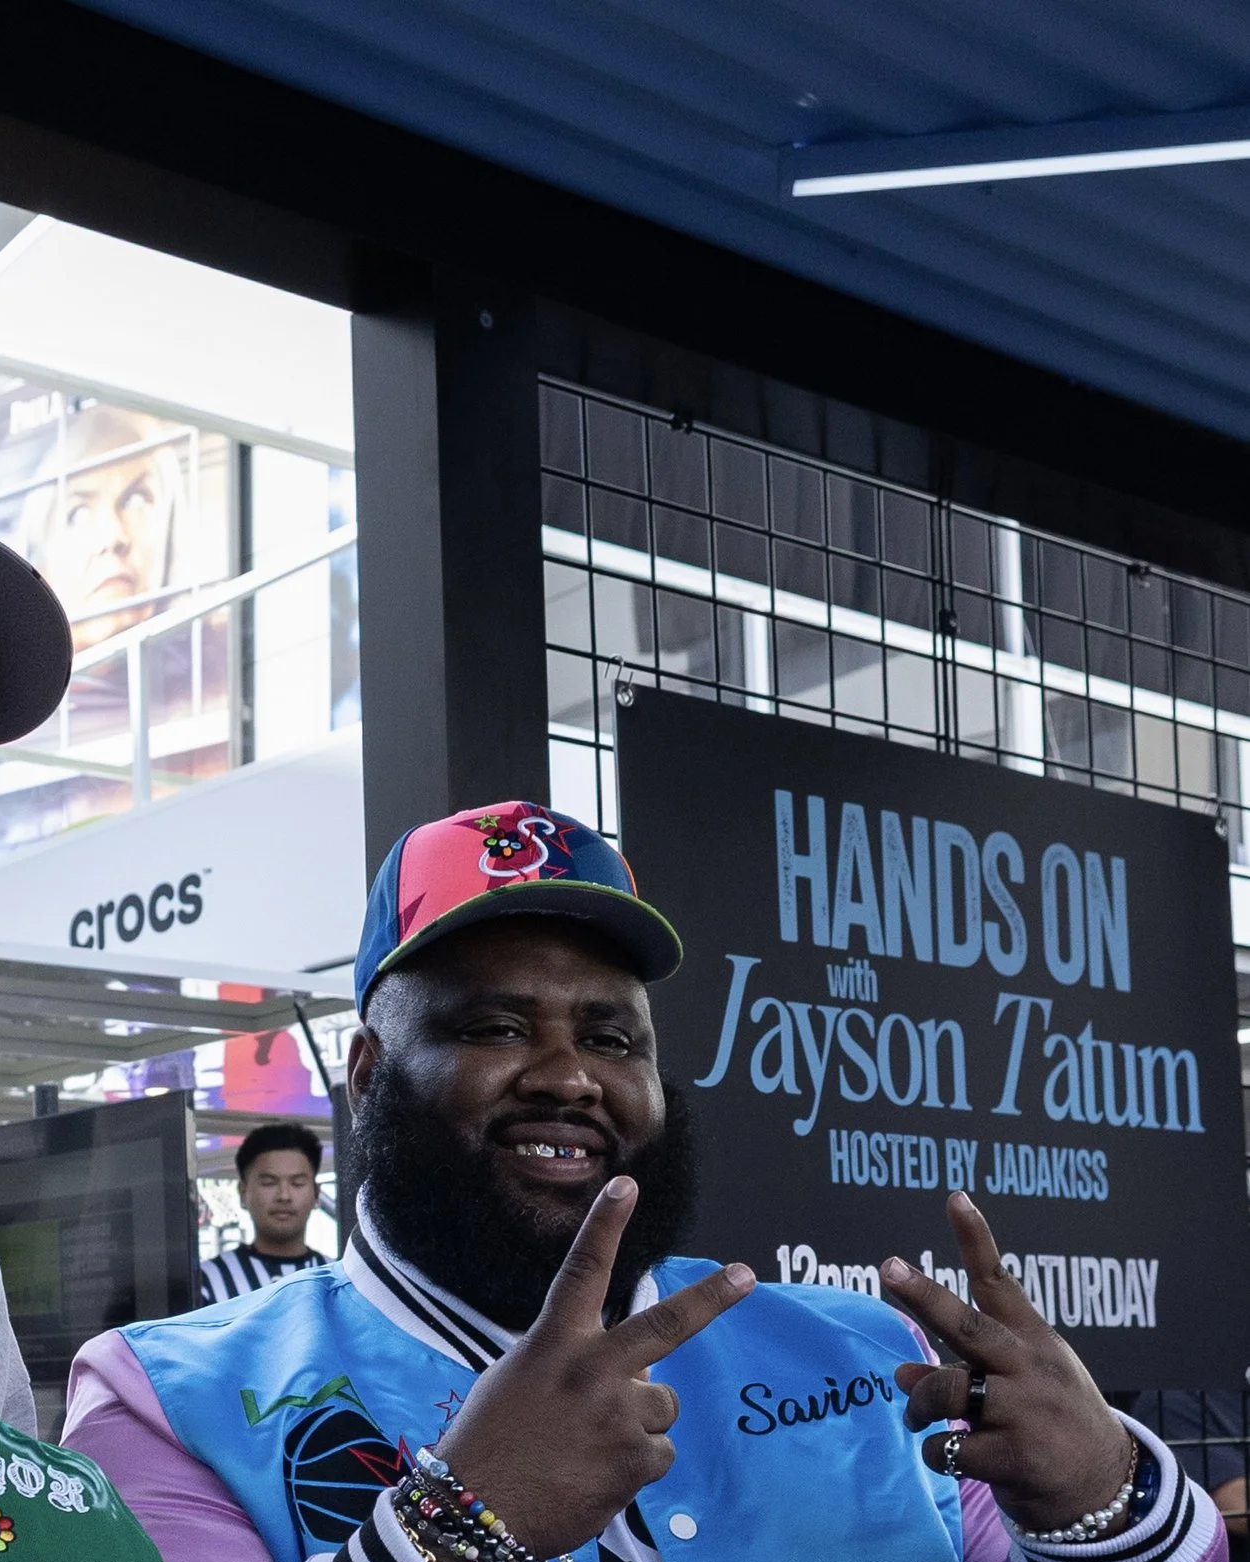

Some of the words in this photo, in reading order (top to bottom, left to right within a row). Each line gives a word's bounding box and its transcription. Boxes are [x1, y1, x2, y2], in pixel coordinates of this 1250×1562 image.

[69, 873, 203, 950] crocs
[774, 790, 1026, 977] HANDS
[1041, 842, 1132, 993] ON
[826, 957, 879, 1003] with
[695, 953, 973, 1136] Jayson
[991, 992, 1206, 1133] Tatum
[830, 1129, 940, 1191] HOSTED
[948, 1139, 978, 1193] BY
[986, 1145, 1110, 1201] JADAKISS
[737, 1370, 893, 1436] Savior
